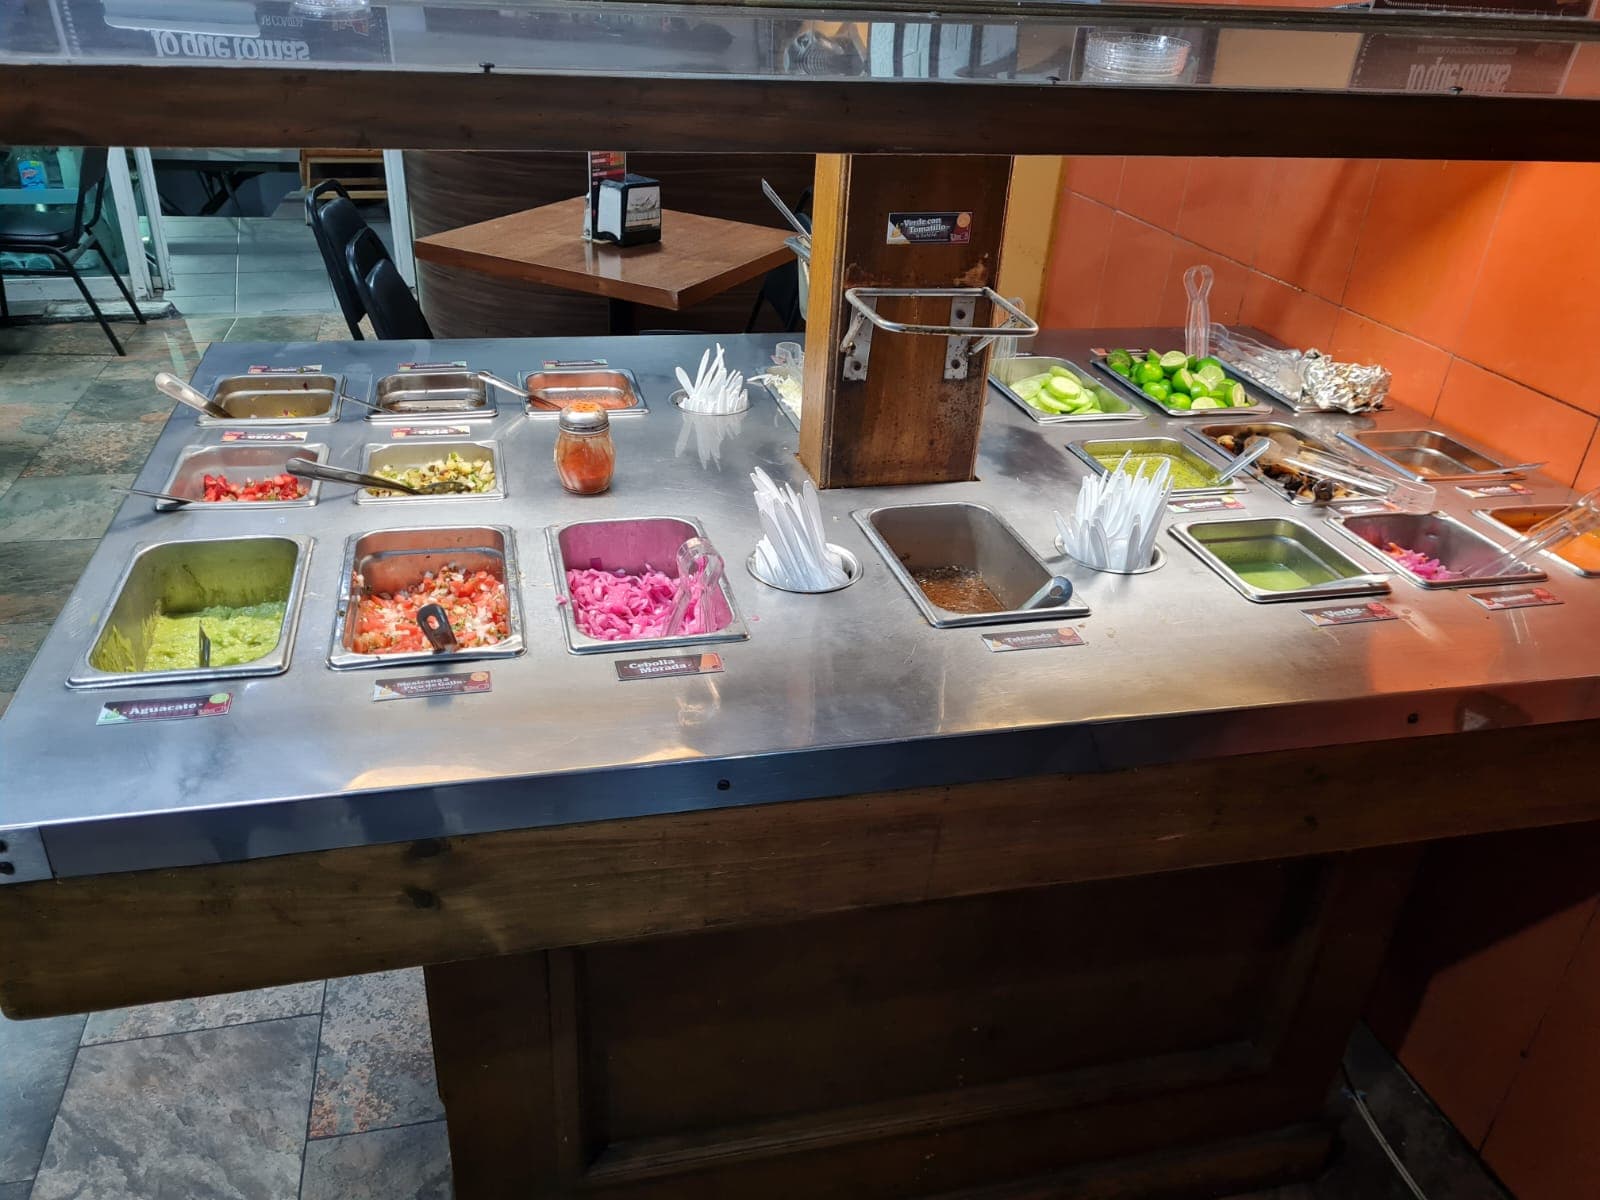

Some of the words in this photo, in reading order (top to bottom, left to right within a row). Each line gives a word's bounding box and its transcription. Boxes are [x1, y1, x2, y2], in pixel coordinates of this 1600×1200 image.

[903, 218, 926, 227] Verde
[927, 217, 942, 225] con
[909, 223, 946, 233] Tomatillo
[628, 659, 676, 669] Cebolla
[640, 663, 687, 674] Morada
[129, 702, 197, 715] Aguacate
